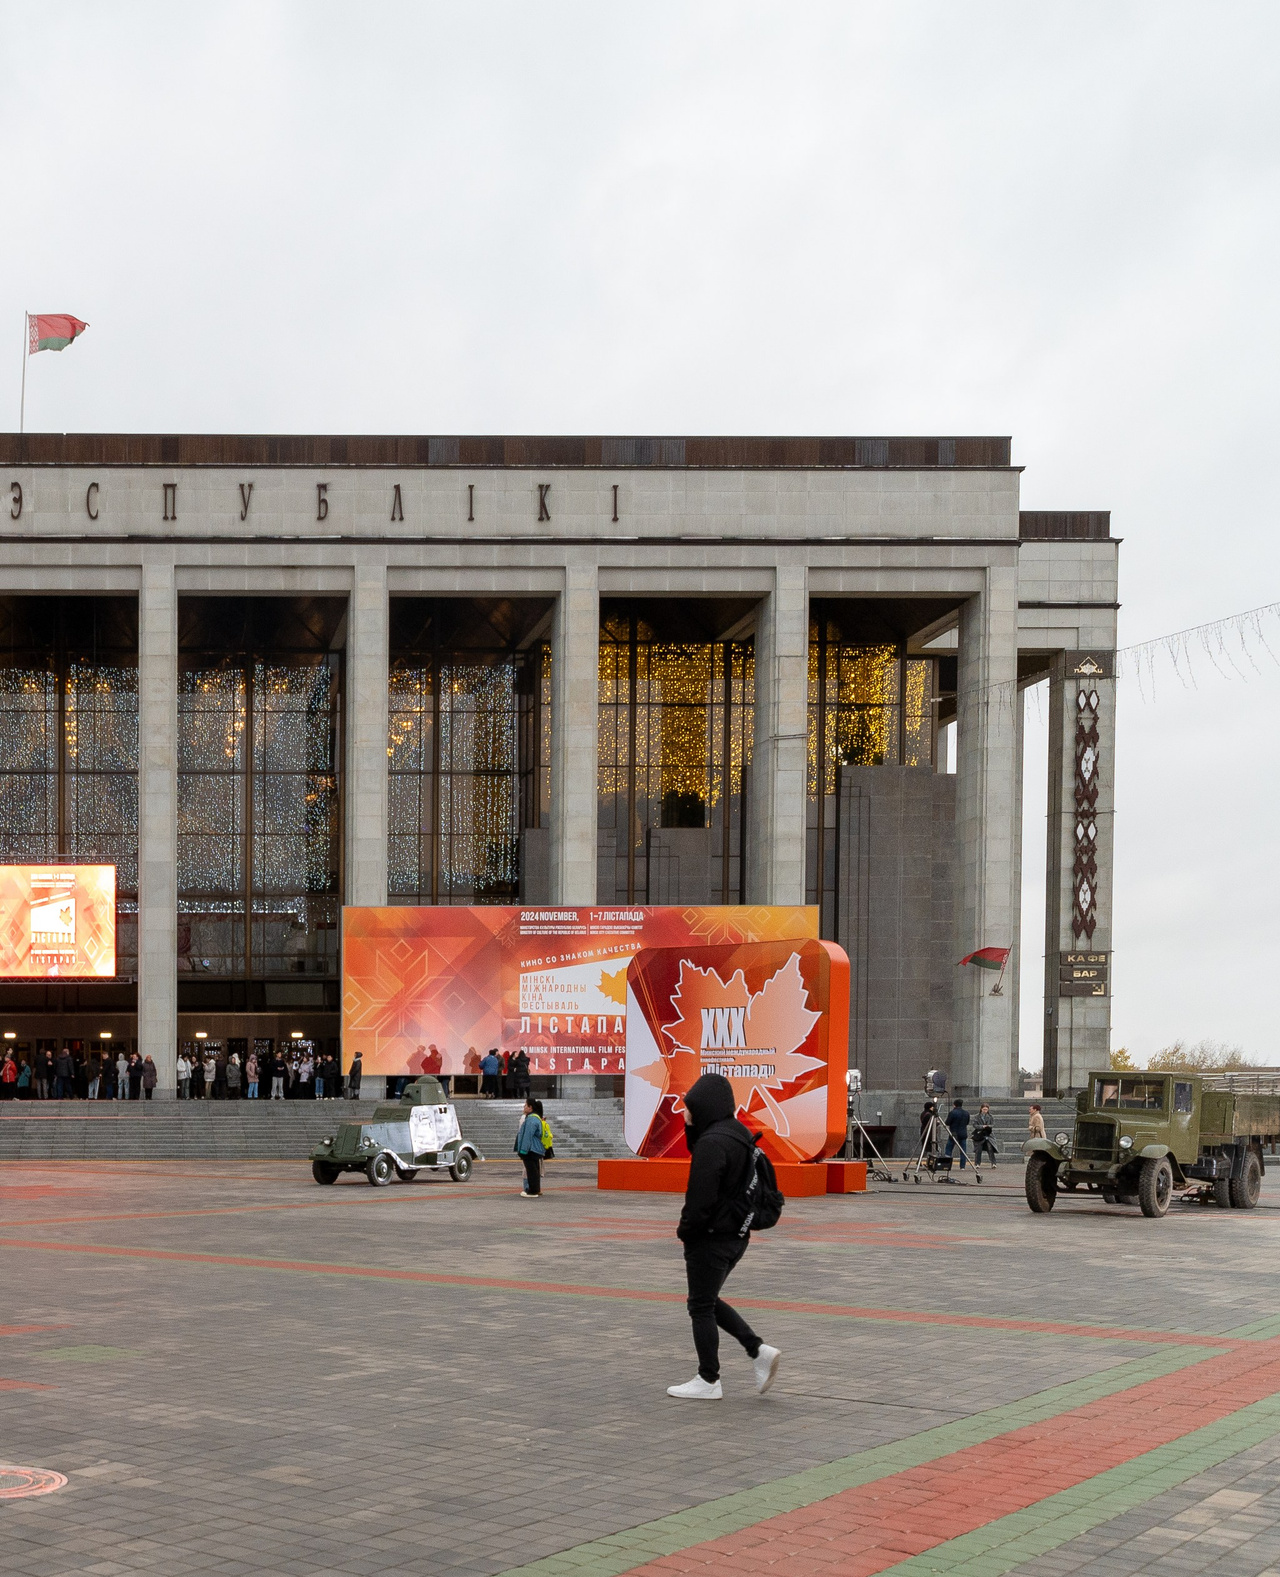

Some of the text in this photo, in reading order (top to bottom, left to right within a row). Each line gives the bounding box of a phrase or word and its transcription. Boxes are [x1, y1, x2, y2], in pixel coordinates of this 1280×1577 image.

[520, 912, 579, 922] 2024 NOVEMBER,
[603, 912, 644, 922] ЛІСТАПАДА
[520, 942, 642, 968] КИНО СО ЗНАКОМ КАЧЕСТВА
[521, 975, 555, 984] МІНСКІ
[521, 984, 587, 993] МІЖНАРОДНЫ
[521, 993, 543, 1001] КІНА
[521, 1001, 579, 1011] ФЕСТЫВАЛЬ
[519, 1016, 624, 1034] ЛІСТАПА
[529, 1046, 548, 1054] MINSK
[550, 1046, 596, 1054] INTERNATIONAL
[598, 1046, 612, 1054] FILM
[614, 1046, 626, 1054] FES
[535, 1058, 625, 1070] ISTAPA
